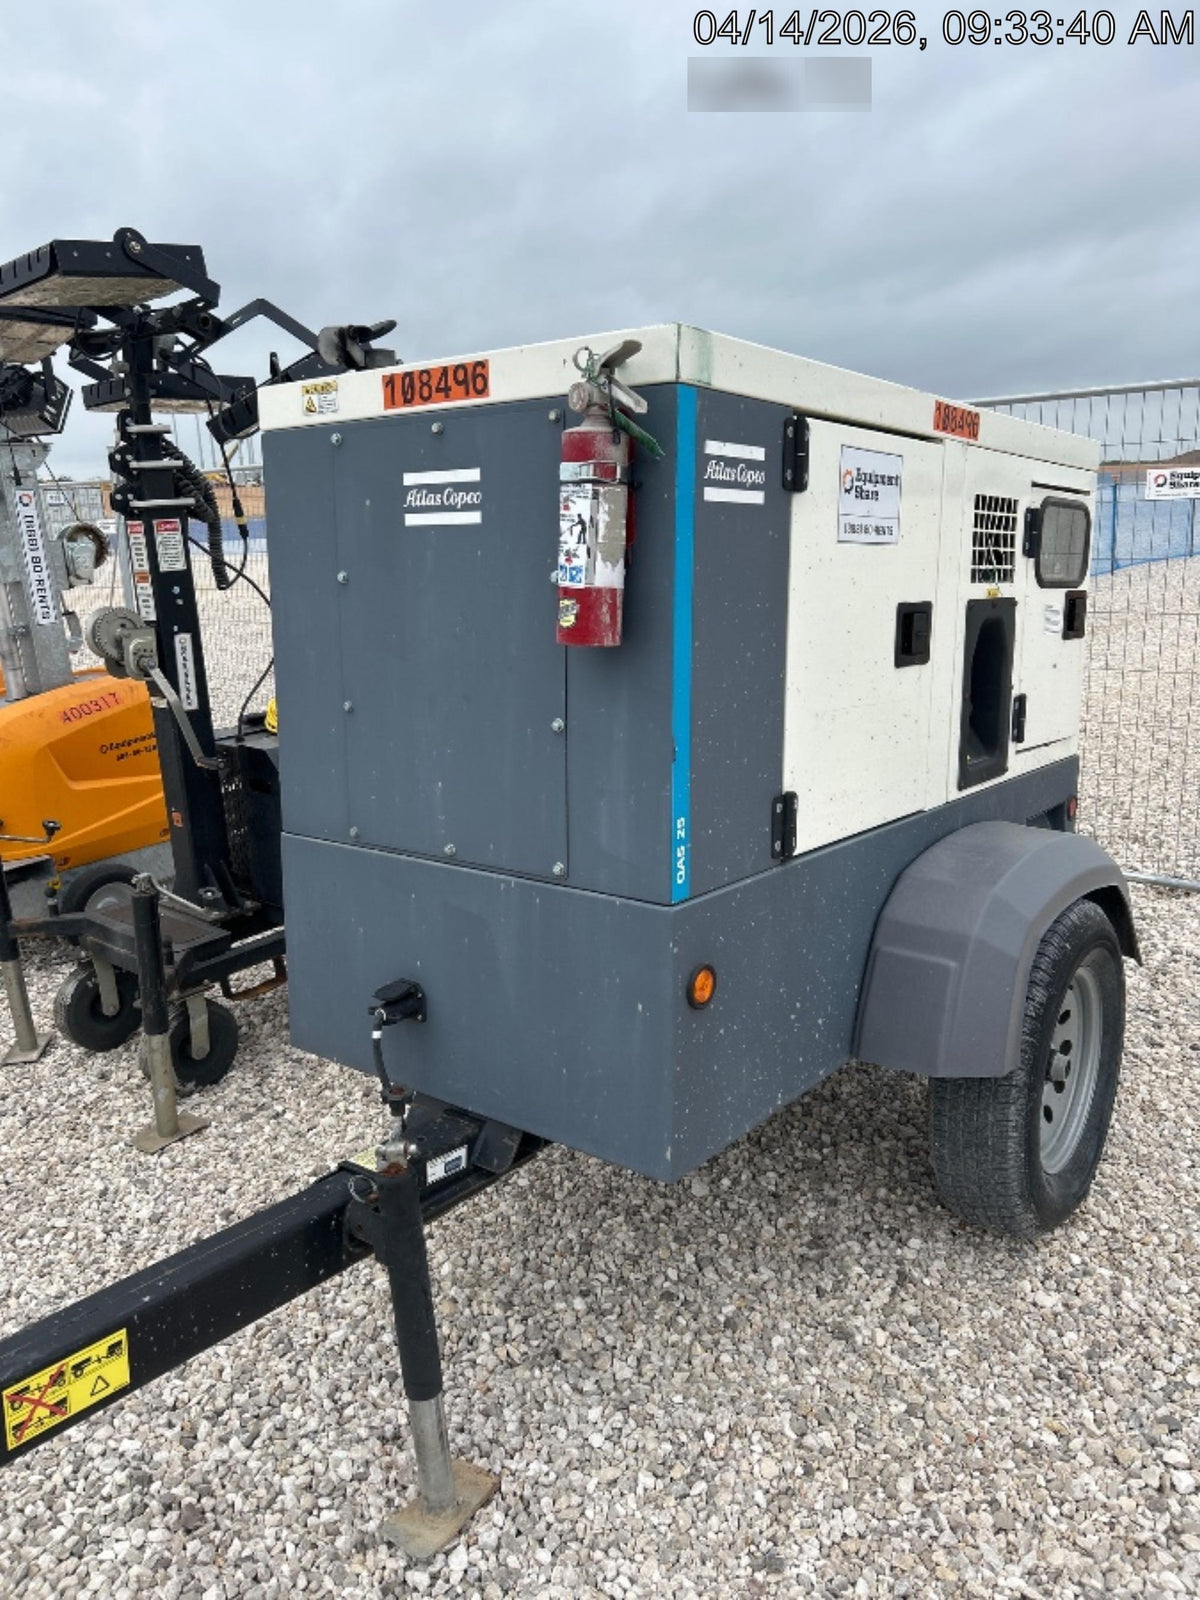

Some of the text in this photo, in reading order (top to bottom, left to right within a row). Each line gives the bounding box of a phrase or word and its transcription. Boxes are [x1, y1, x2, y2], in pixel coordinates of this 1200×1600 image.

[384, 361, 489, 406] 108496
[703, 460, 766, 487] Atlas Copco
[403, 486, 482, 509] Atlas Copco
[677, 817, 686, 885] QAS 25
